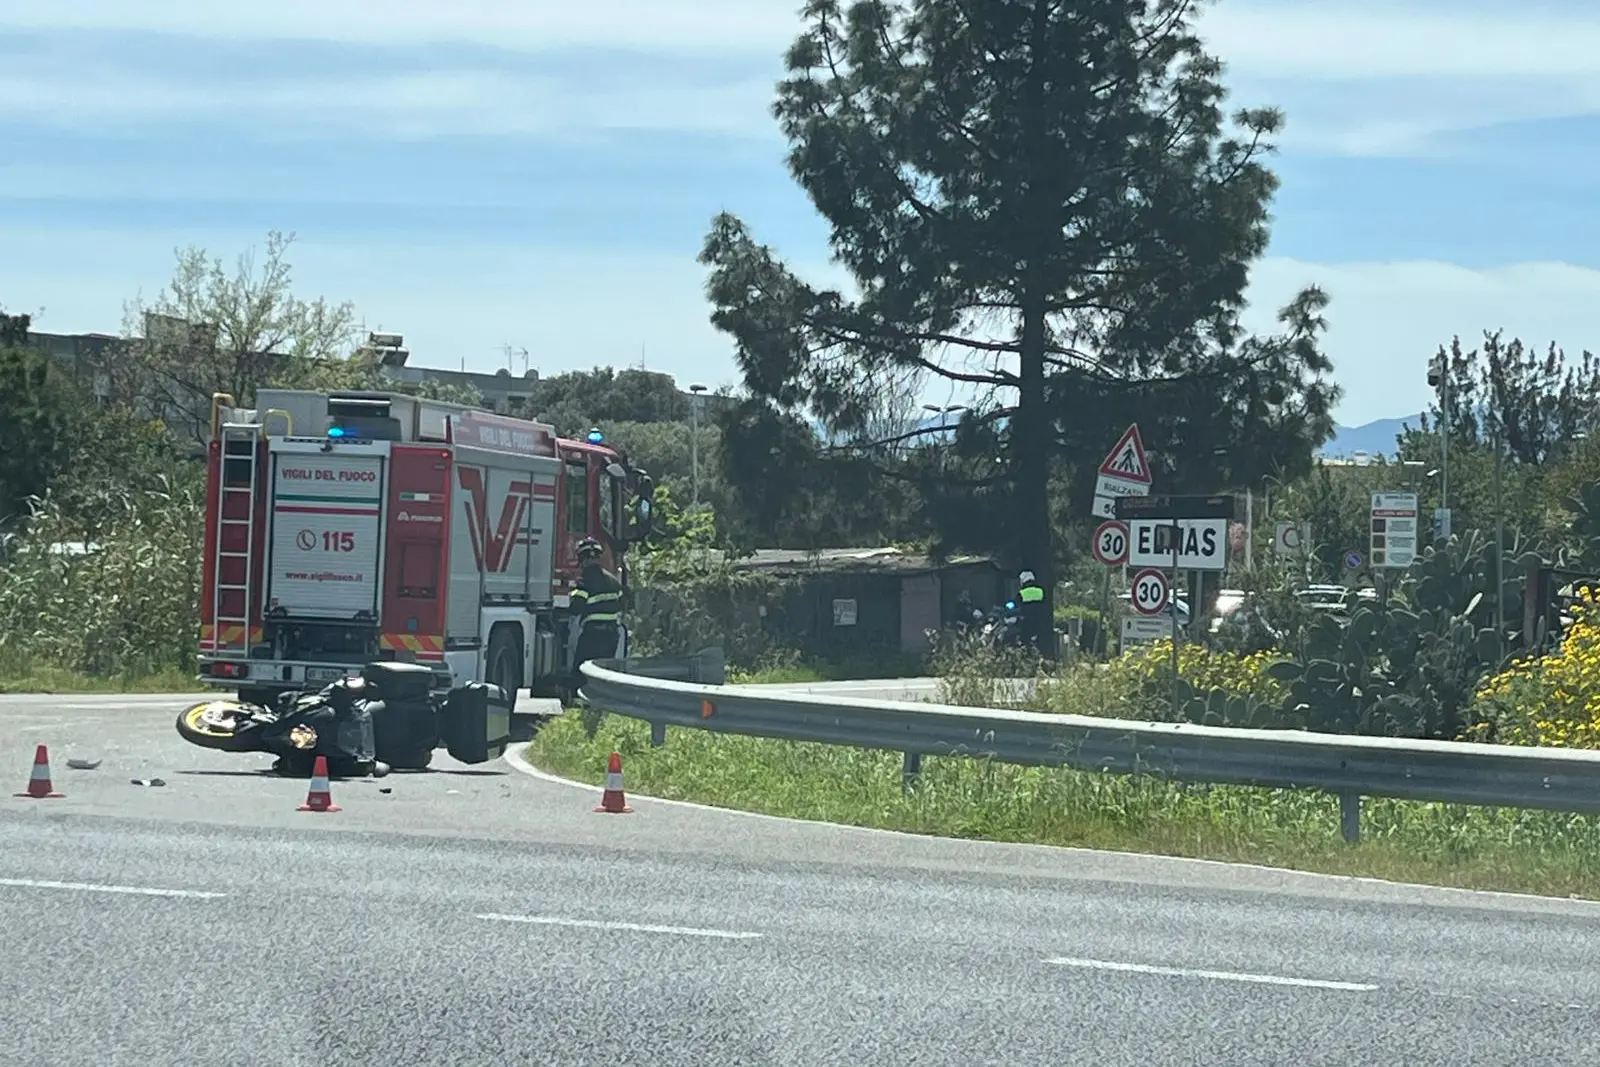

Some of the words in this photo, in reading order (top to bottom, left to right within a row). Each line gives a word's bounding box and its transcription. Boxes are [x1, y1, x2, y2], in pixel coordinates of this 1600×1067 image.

[282, 468, 312, 480] VIGILI
[315, 470, 336, 481] DEL
[339, 470, 376, 482] FUOCO
[322, 531, 355, 552] 115
[1101, 533, 1124, 555] 30
[1139, 582, 1161, 603] 30
